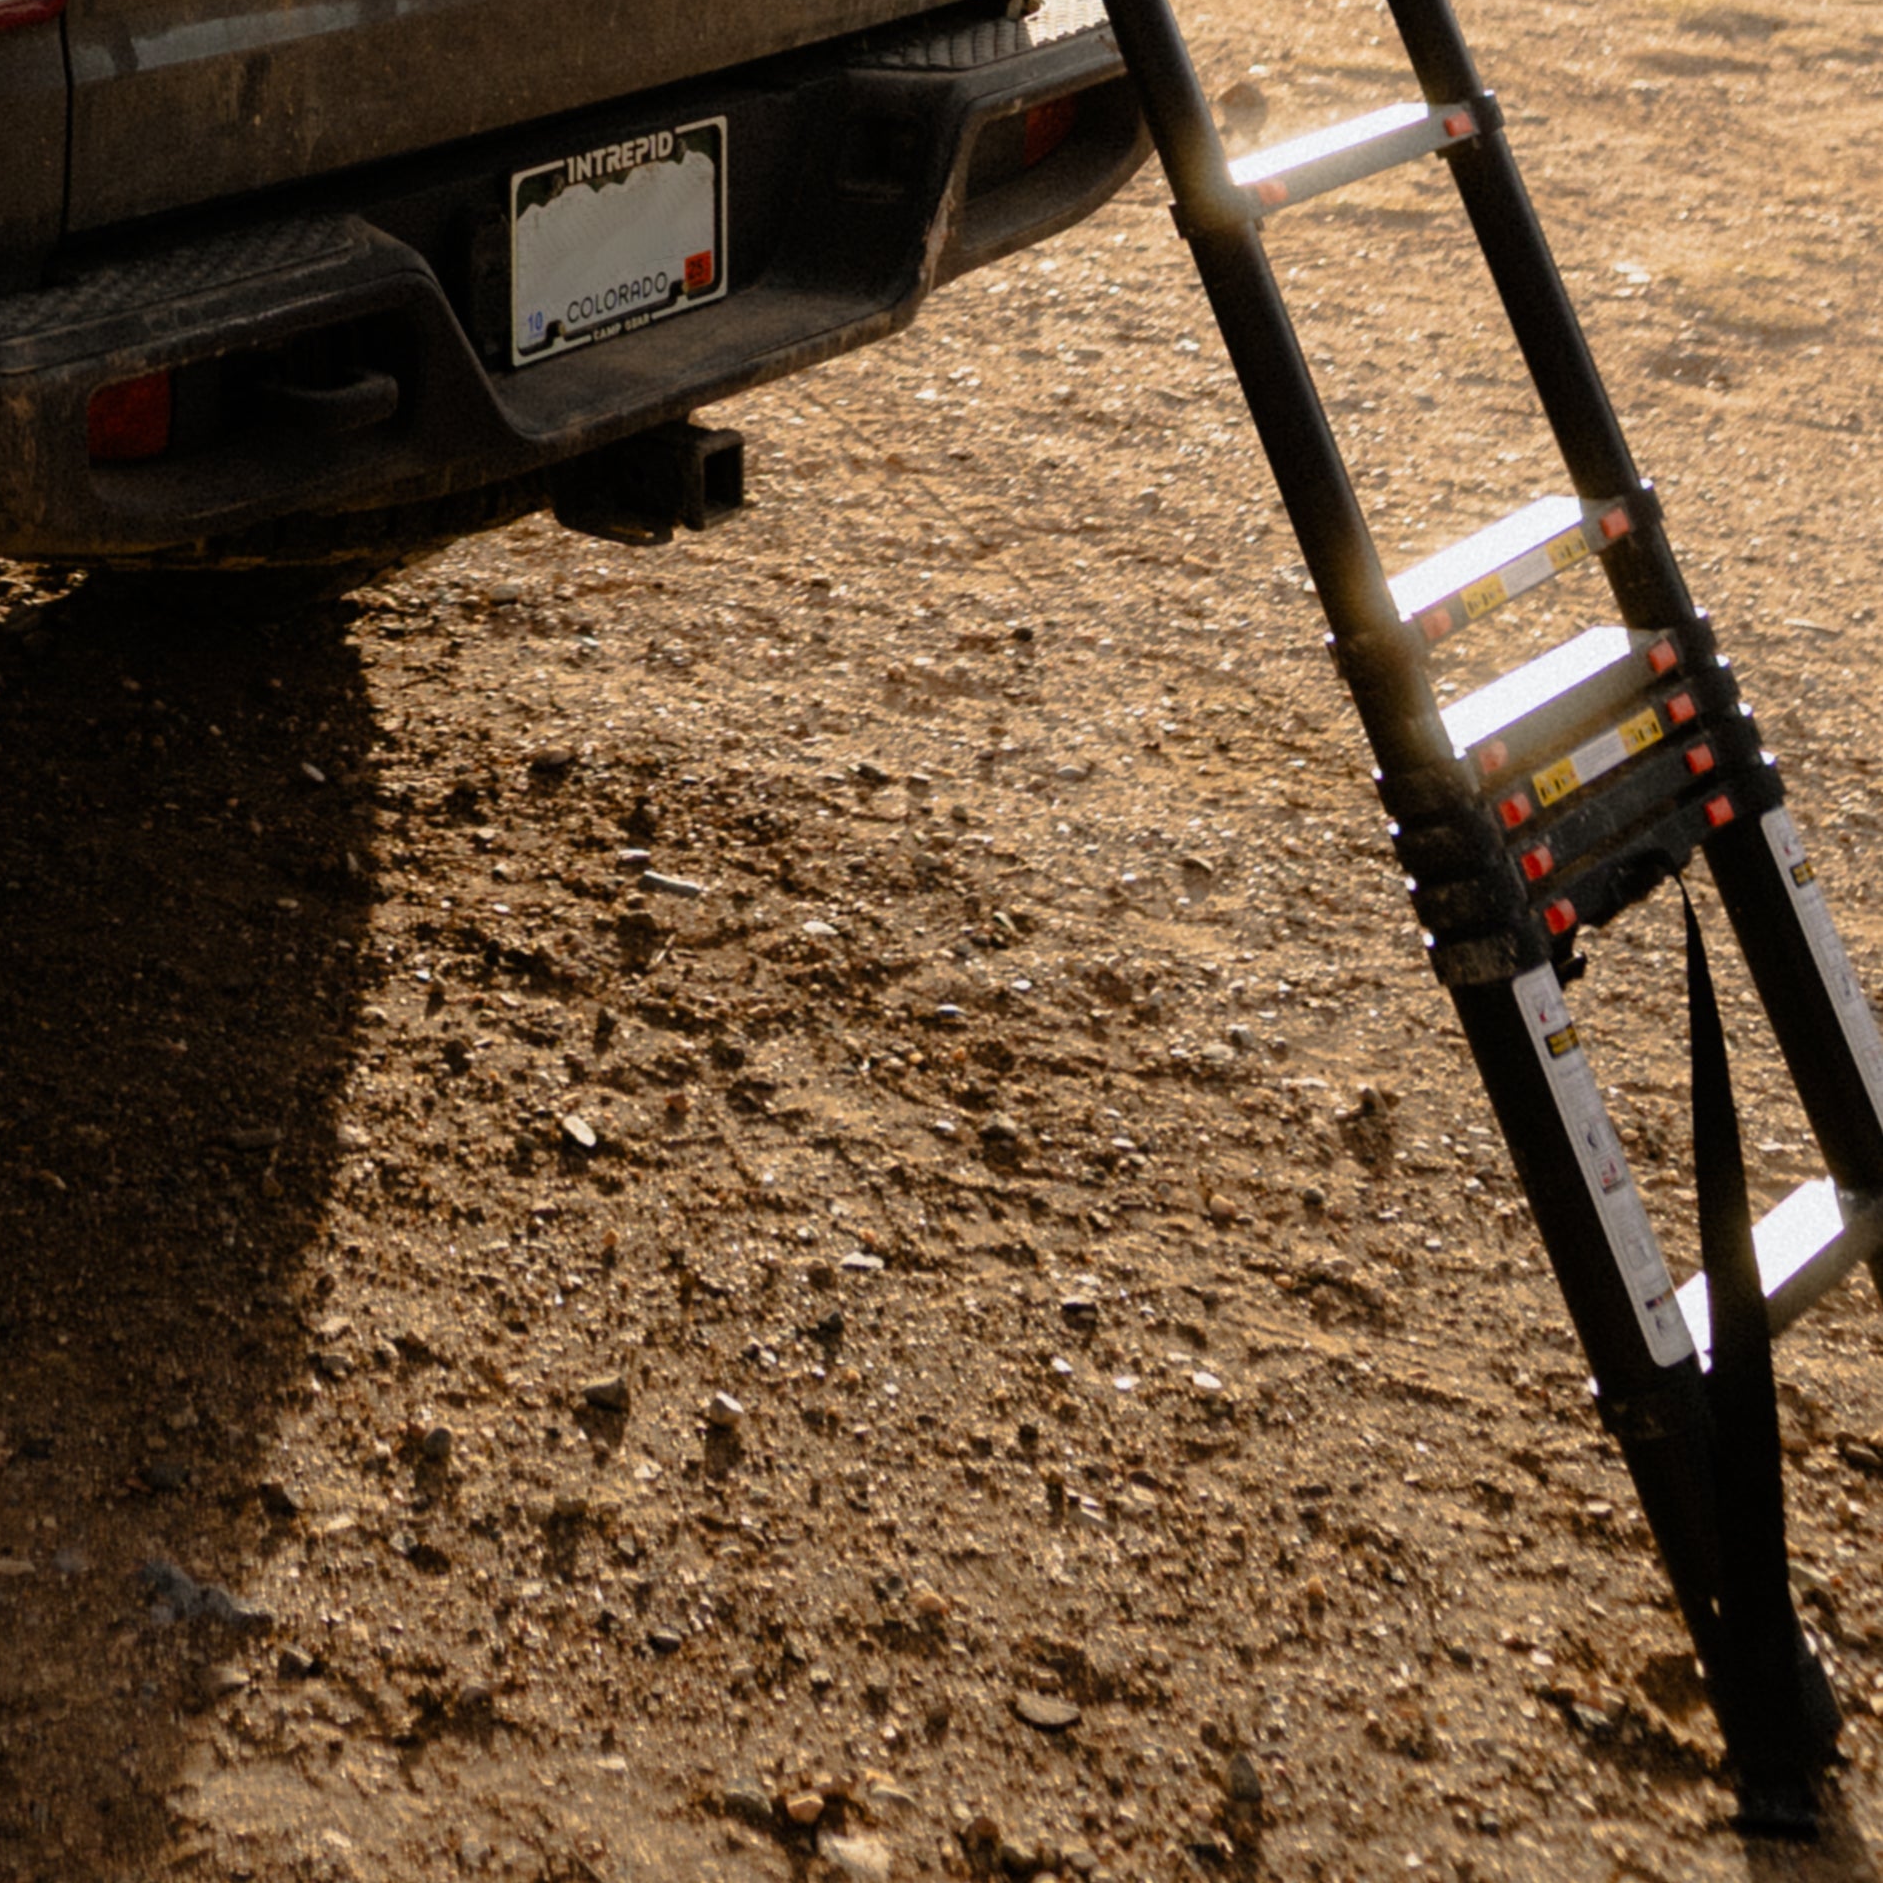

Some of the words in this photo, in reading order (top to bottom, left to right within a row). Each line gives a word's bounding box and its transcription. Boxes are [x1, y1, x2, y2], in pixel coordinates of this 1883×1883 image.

[566, 130, 675, 184] INTREPID
[527, 310, 544, 332] 10
[567, 271, 668, 323] COLORADO
